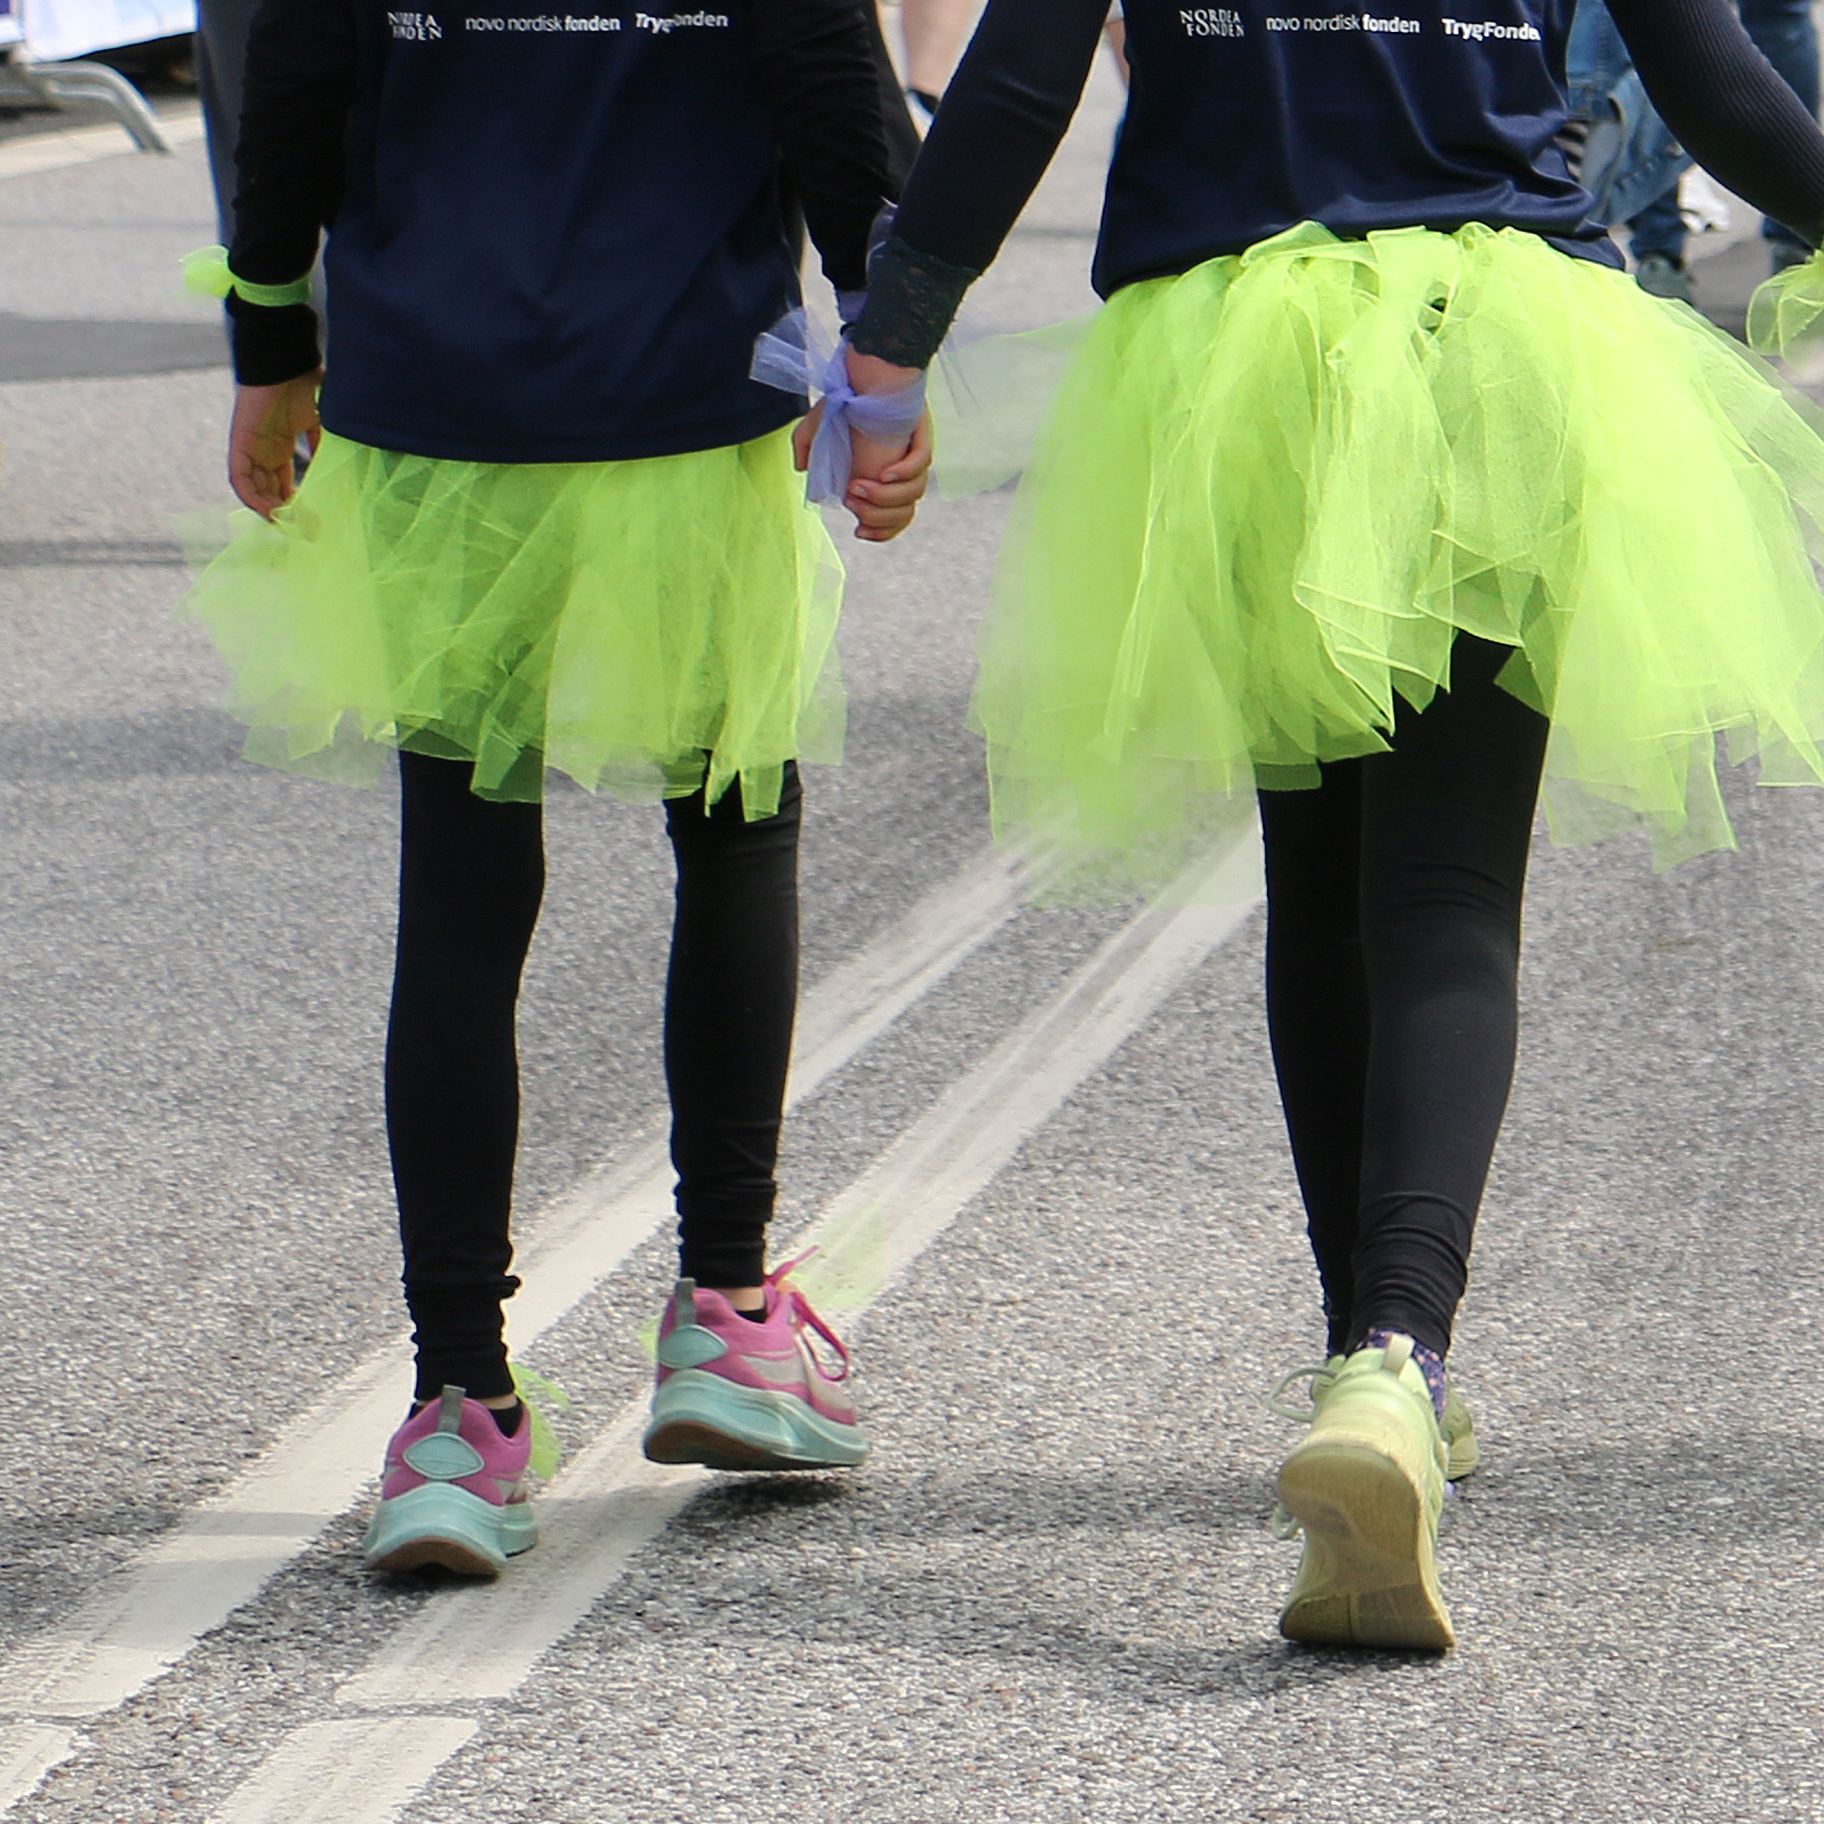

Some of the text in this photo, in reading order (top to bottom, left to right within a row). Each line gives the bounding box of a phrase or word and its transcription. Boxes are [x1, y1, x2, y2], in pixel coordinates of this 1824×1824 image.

[464, 17, 504, 32] novo
[507, 14, 563, 33] nordisk
[1179, 8, 1242, 26] NORDEA
[1265, 17, 1301, 32] novo
[1303, 13, 1360, 32] nordisk
[1361, 13, 1421, 34] fonden
[1186, 22, 1245, 38] FONDEN
